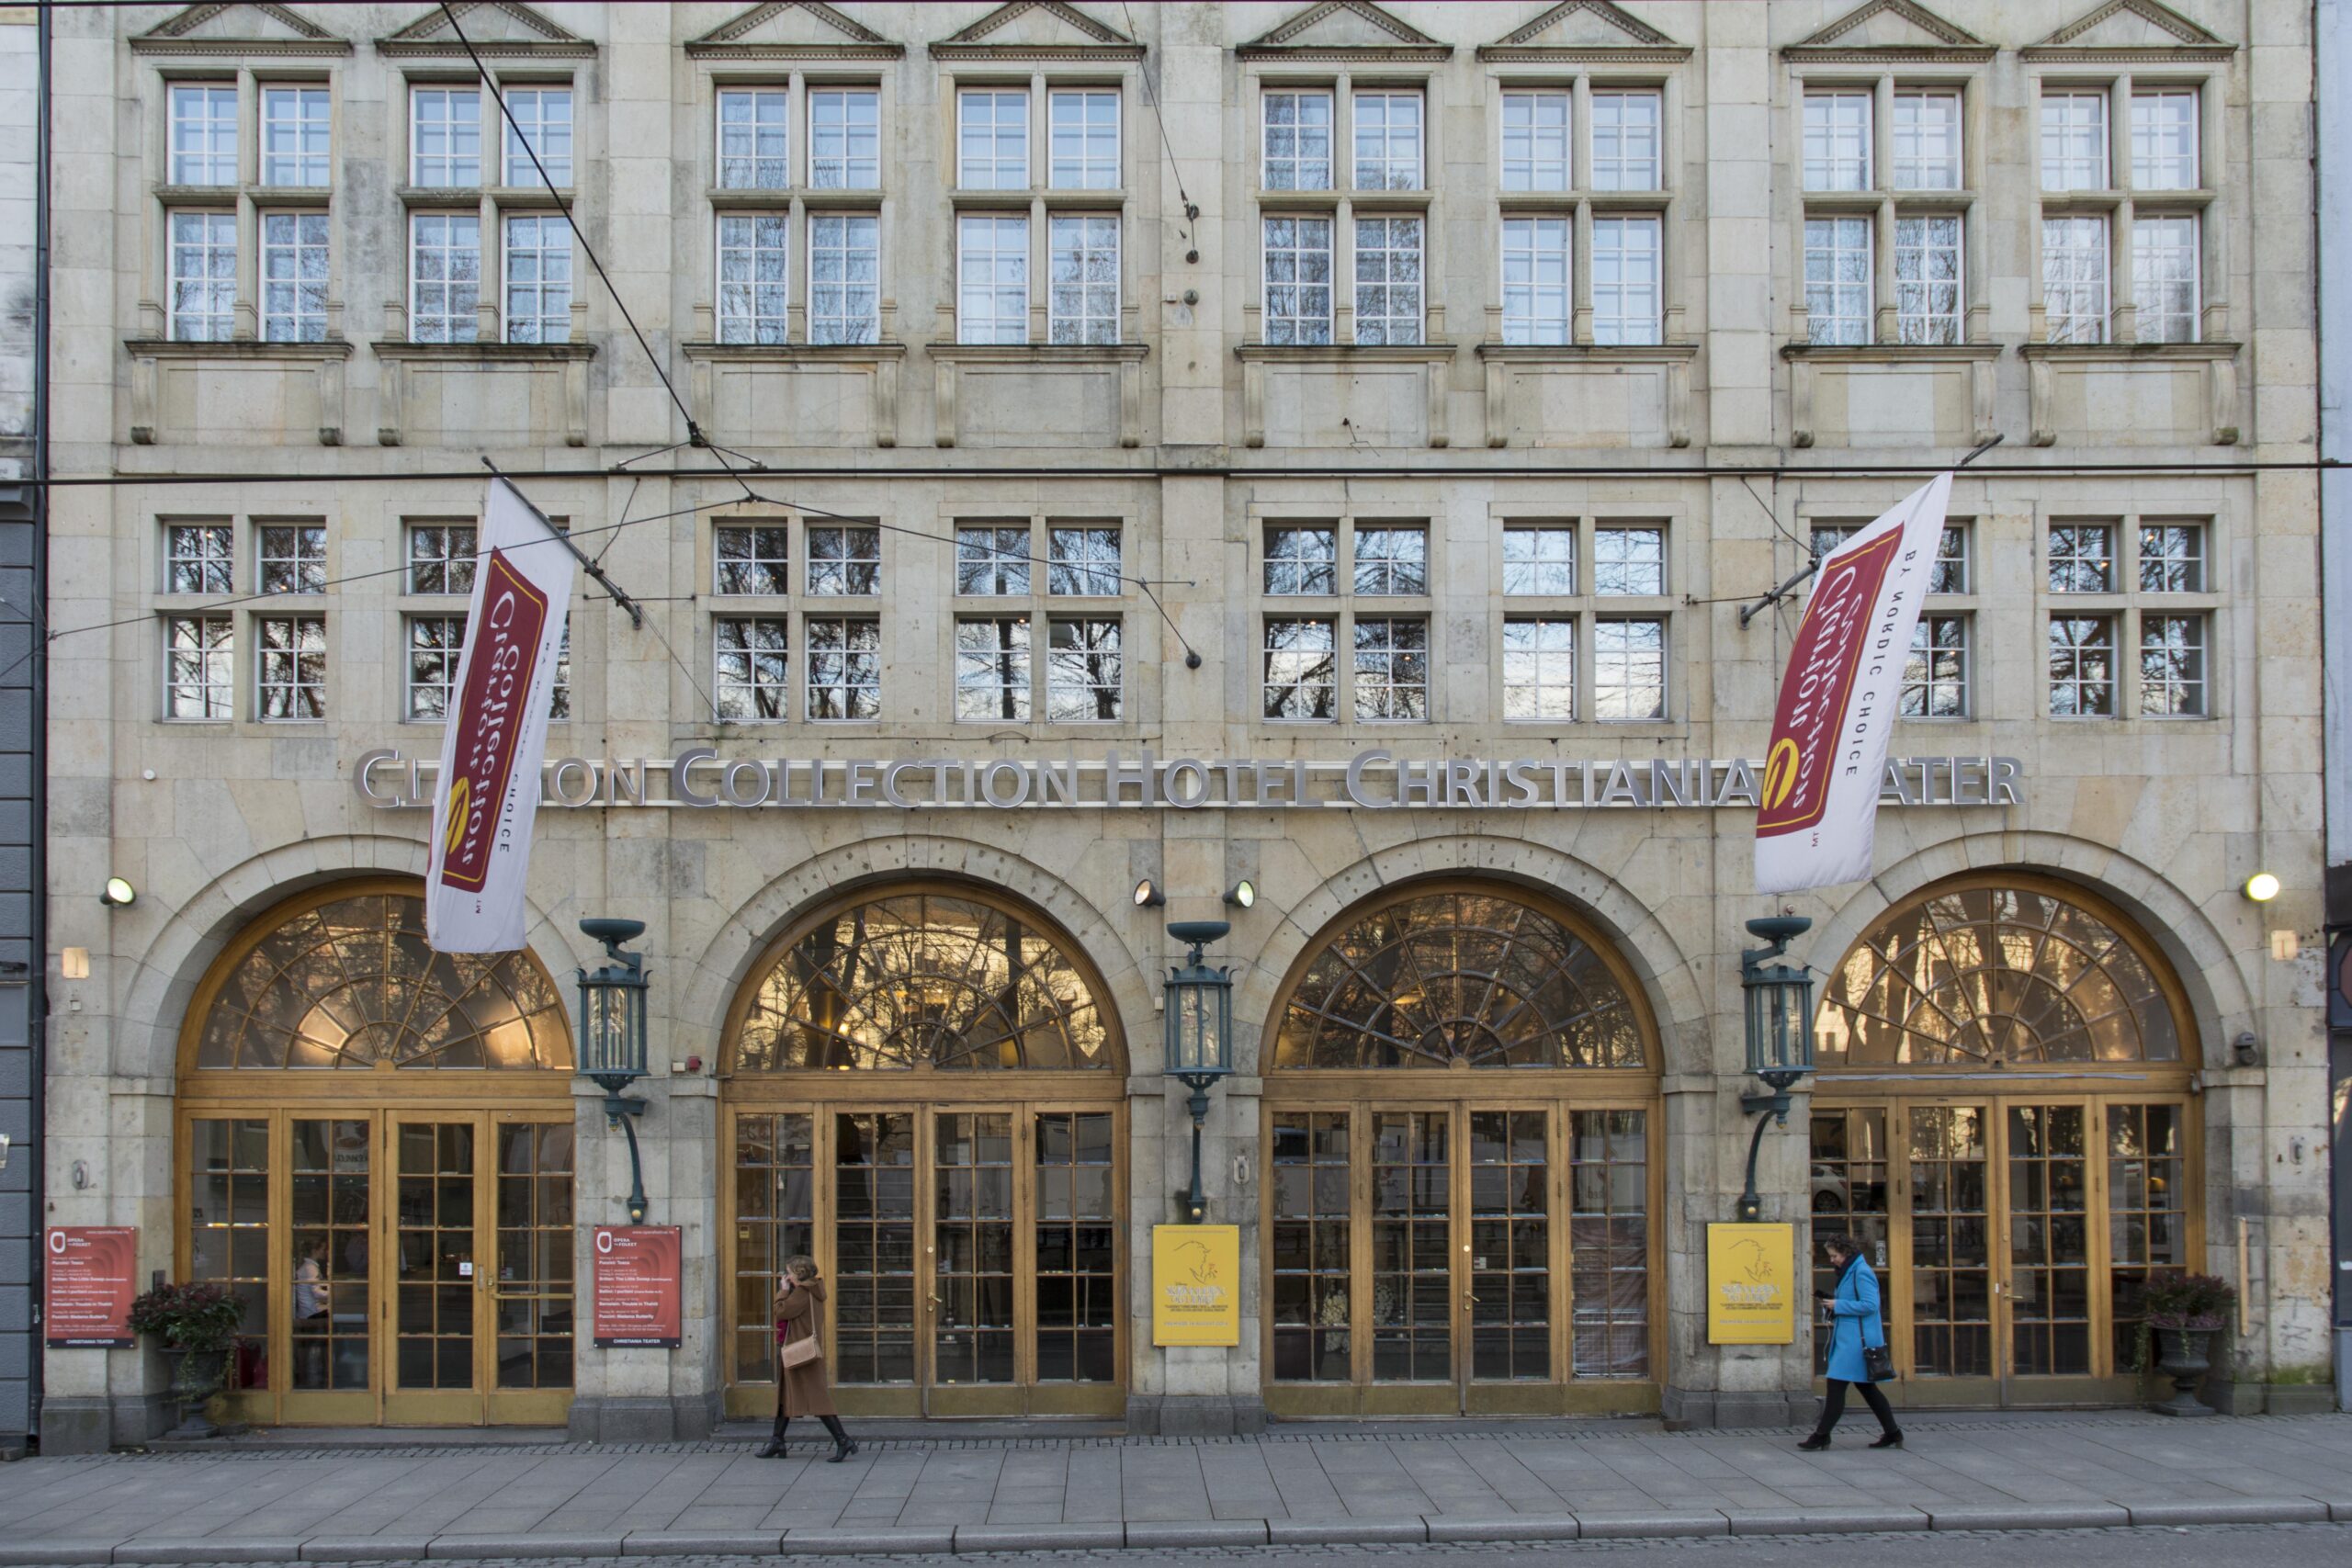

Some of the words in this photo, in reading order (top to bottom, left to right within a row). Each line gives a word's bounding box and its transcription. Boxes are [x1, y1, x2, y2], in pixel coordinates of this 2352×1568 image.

[353, 749, 646, 808] CLON
[672, 748, 1079, 808] COLLECTION
[1106, 748, 1325, 808] HOTEL
[1346, 749, 1761, 809] CHRISTIANIA
[1880, 755, 2028, 806] ATER
